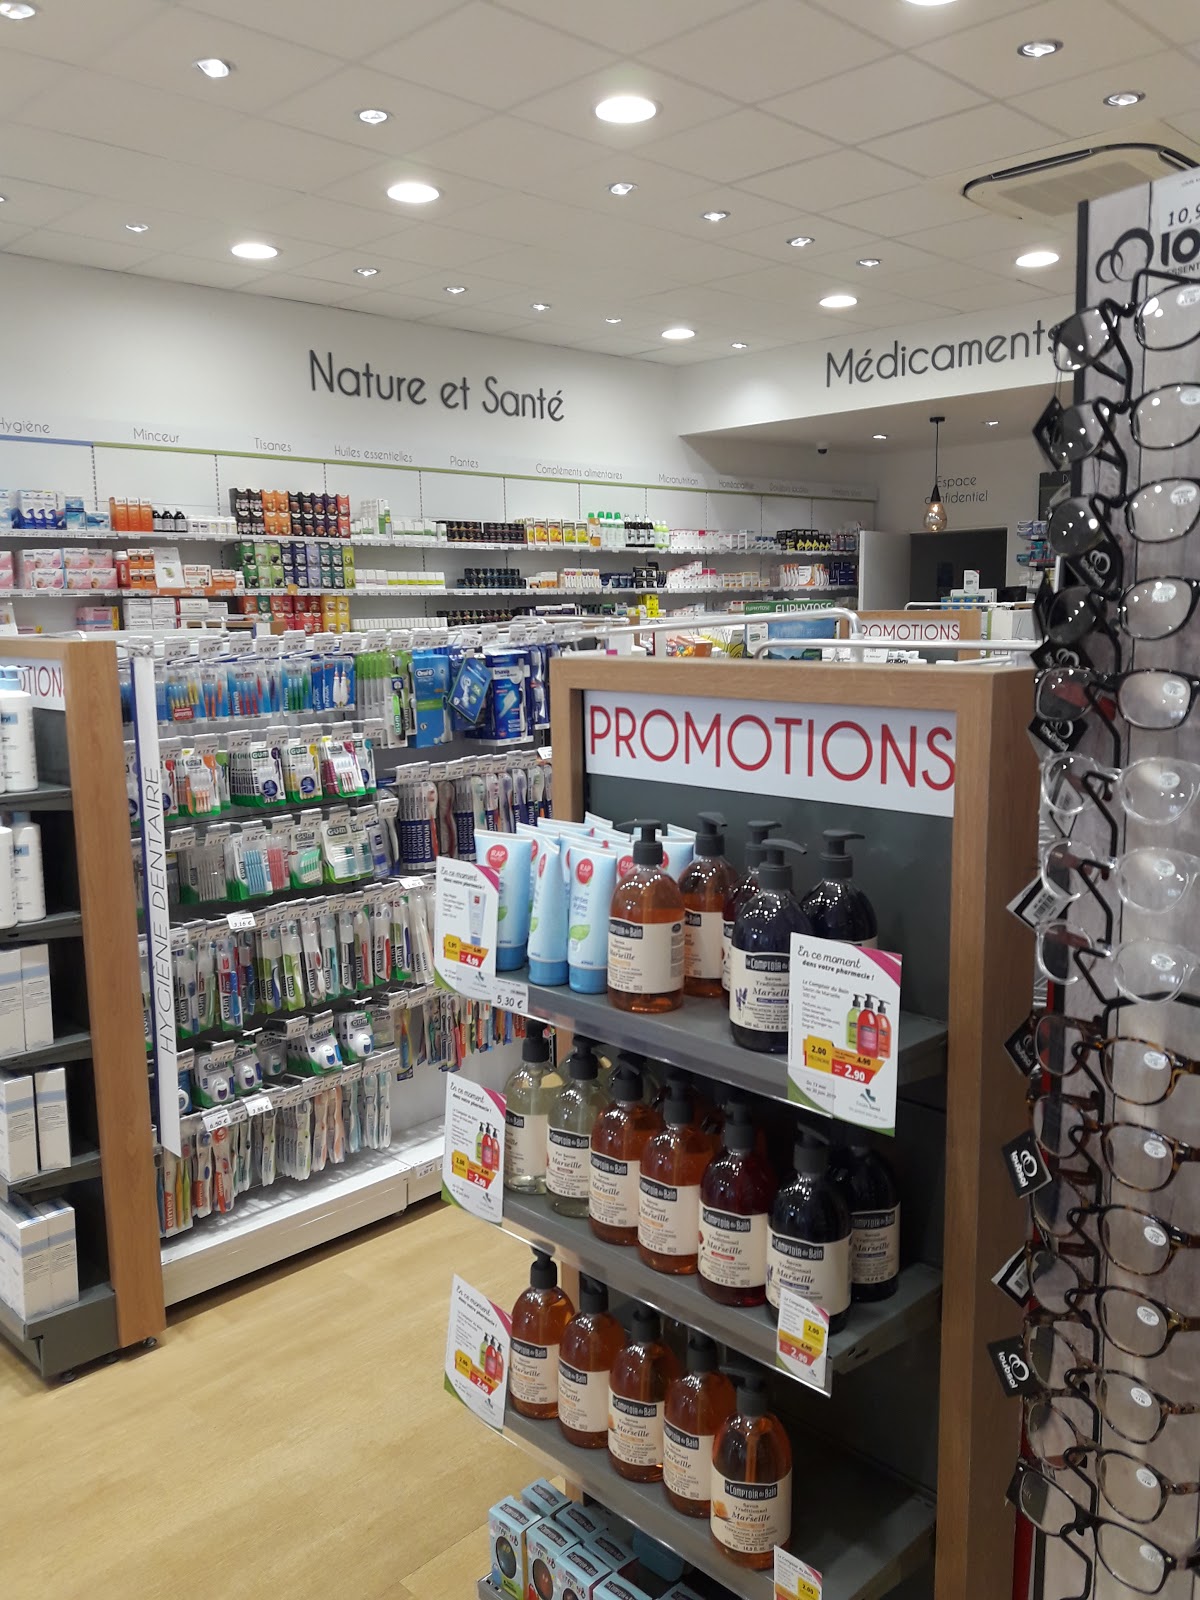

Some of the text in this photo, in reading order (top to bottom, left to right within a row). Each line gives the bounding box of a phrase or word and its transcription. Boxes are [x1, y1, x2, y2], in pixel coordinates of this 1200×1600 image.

[827, 320, 1057, 387] Médicaments
[309, 350, 565, 422] Nature et Santé
[133, 427, 180, 443] Minceur
[254, 437, 292, 453] Tisanes
[334, 446, 412, 463] Huiles essentielles
[449, 455, 479, 468] Plantes
[535, 463, 623, 480] Compléments alimentaires
[658, 474, 699, 486] Micronutrition
[937, 475, 977, 489] Espace
[924, 490, 988, 505] cnfidentiel
[590, 704, 955, 791] PROMOTIONS
[328, 826, 347, 836] GUM
[144, 766, 174, 1055] HYGIÈNE DENTAIRE
[798, 945, 862, 969] En ce moment
[802, 960, 817, 968] dans
[818, 964, 834, 973] votre
[835, 967, 871, 981] pharmacie
[753, 987, 789, 997] Marseill
[552, 1157, 582, 1169] Marseille
[1010, 1150, 1029, 1188] loubsol
[593, 1182, 620, 1196] Marseille
[641, 1207, 669, 1222] Marseille
[707, 1240, 742, 1255] Marseille
[808, 1247, 823, 1259] Bain
[854, 1242, 890, 1252] Marseille
[777, 1268, 815, 1284] Marseille
[512, 1364, 541, 1378] Marseille
[998, 1351, 1018, 1389] loubsol
[617, 1424, 650, 1438] Marseille
[664, 1450, 692, 1469] Marseille
[765, 1485, 777, 1499] Bain
[731, 1511, 771, 1521] Marseille
